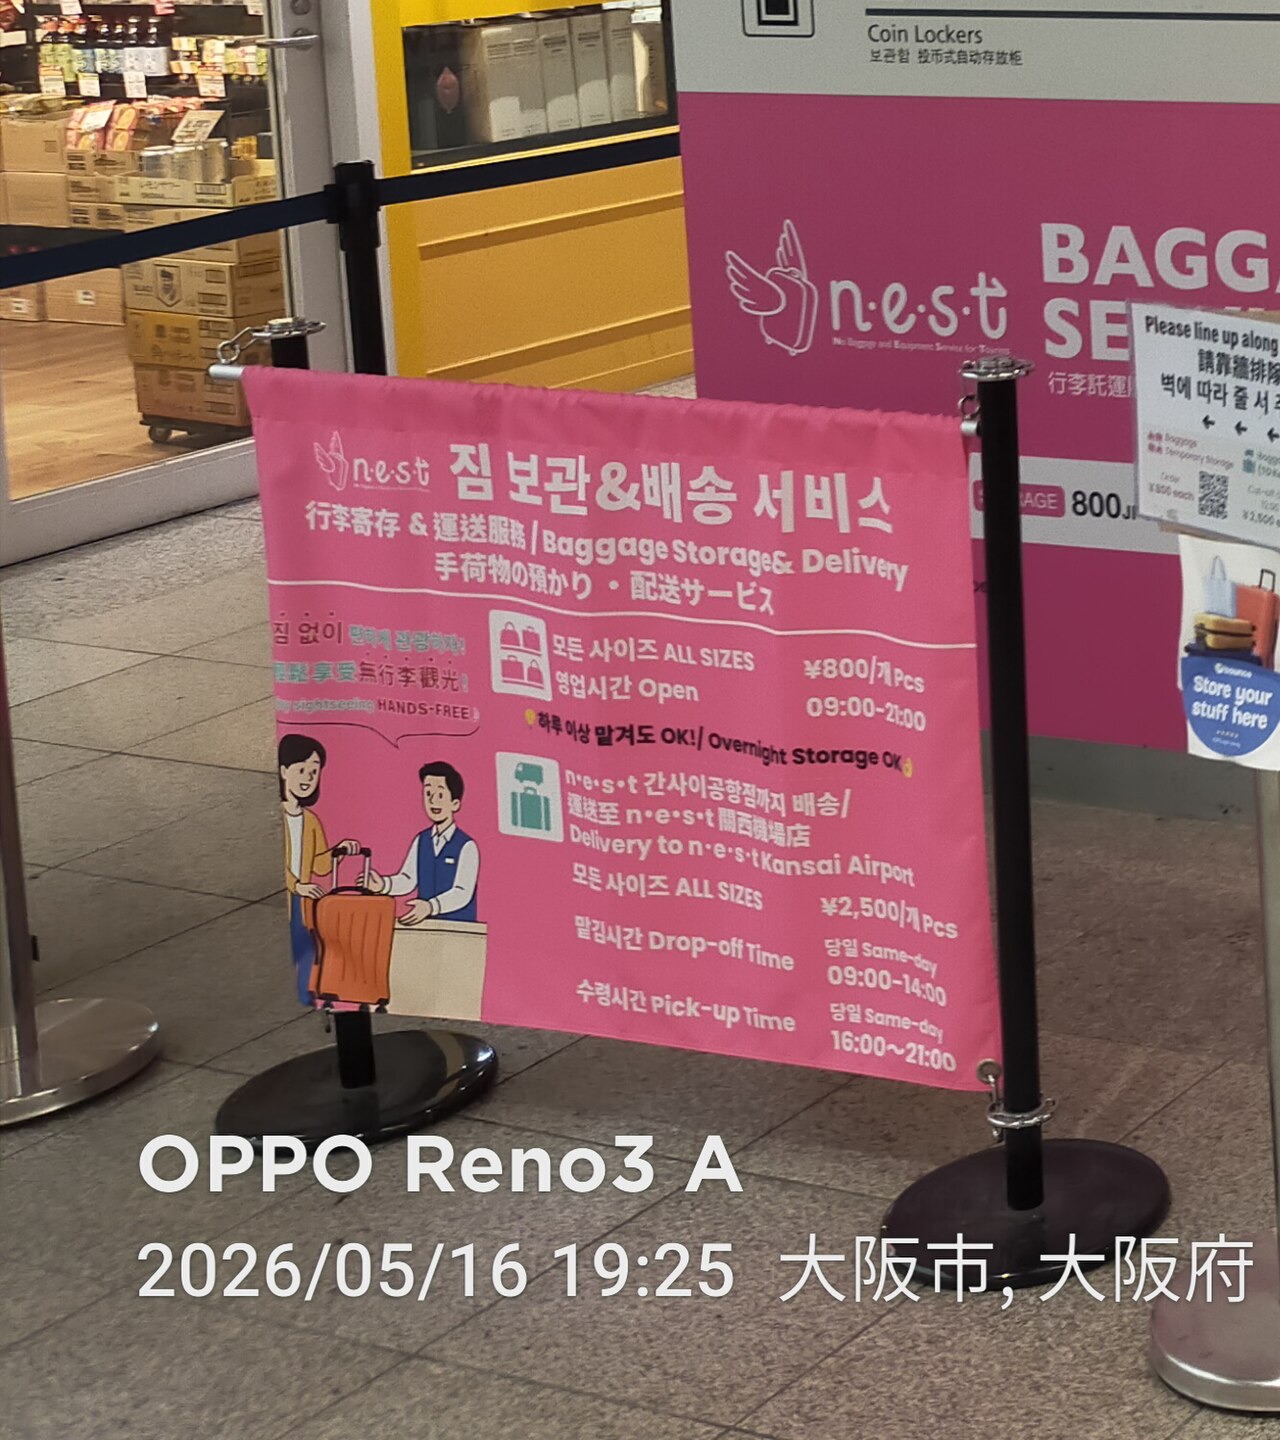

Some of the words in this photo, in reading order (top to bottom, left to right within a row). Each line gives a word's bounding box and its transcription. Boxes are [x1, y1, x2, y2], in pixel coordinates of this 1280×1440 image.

[867, 24, 908, 43] Coin
[914, 24, 983, 44] Lockers
[1145, 315, 1191, 338] Please
[1194, 321, 1219, 342] line
[1222, 330, 1239, 350] up
[1241, 331, 1278, 357] along
[1048, 371, 1132, 398] 行李託運
[1161, 373, 1191, 399] 벽에
[1197, 380, 1228, 407] 따라
[1233, 385, 1249, 410] 줄
[1253, 390, 1269, 415] 서
[450, 443, 494, 501] 짐
[754, 470, 893, 533] 서비스
[1072, 491, 1121, 518] 800
[305, 500, 400, 539] 行李寄存
[409, 513, 428, 537] &
[802, 547, 908, 592] Delivery
[552, 634, 584, 660] 모든
[589, 637, 658, 662] 사이즈
[664, 643, 697, 665] ALL
[700, 647, 755, 671] SIZES
[555, 671, 631, 700] 영업시간
[639, 678, 699, 703] Open
[806, 696, 926, 731] 09:00-21:00
[1193, 675, 1232, 698] Store
[1234, 686, 1273, 706] your
[1191, 700, 1230, 722] stuff
[1231, 706, 1268, 729] here
[566, 721, 590, 744] 이상
[708, 732, 787, 766] Overnight
[792, 747, 879, 769] Storage
[569, 824, 652, 860] Delivery
[657, 835, 683, 855] to
[761, 853, 841, 876] Kansai
[847, 854, 915, 887] Airport
[572, 862, 602, 891] 모든
[606, 872, 669, 897] 사이즈
[675, 878, 714, 899] ALL
[718, 881, 763, 910] SIZES
[648, 930, 744, 960] Drop-off
[747, 943, 795, 971] Time
[825, 938, 859, 958] 당일
[862, 942, 937, 979] Same-day
[827, 965, 947, 1006] 09:00-14:00
[576, 978, 647, 1013] 수령시간
[651, 994, 740, 1028] Pick-up
[743, 1007, 796, 1032] Time
[830, 1003, 862, 1023] 당일
[865, 1008, 943, 1043] Same-day
